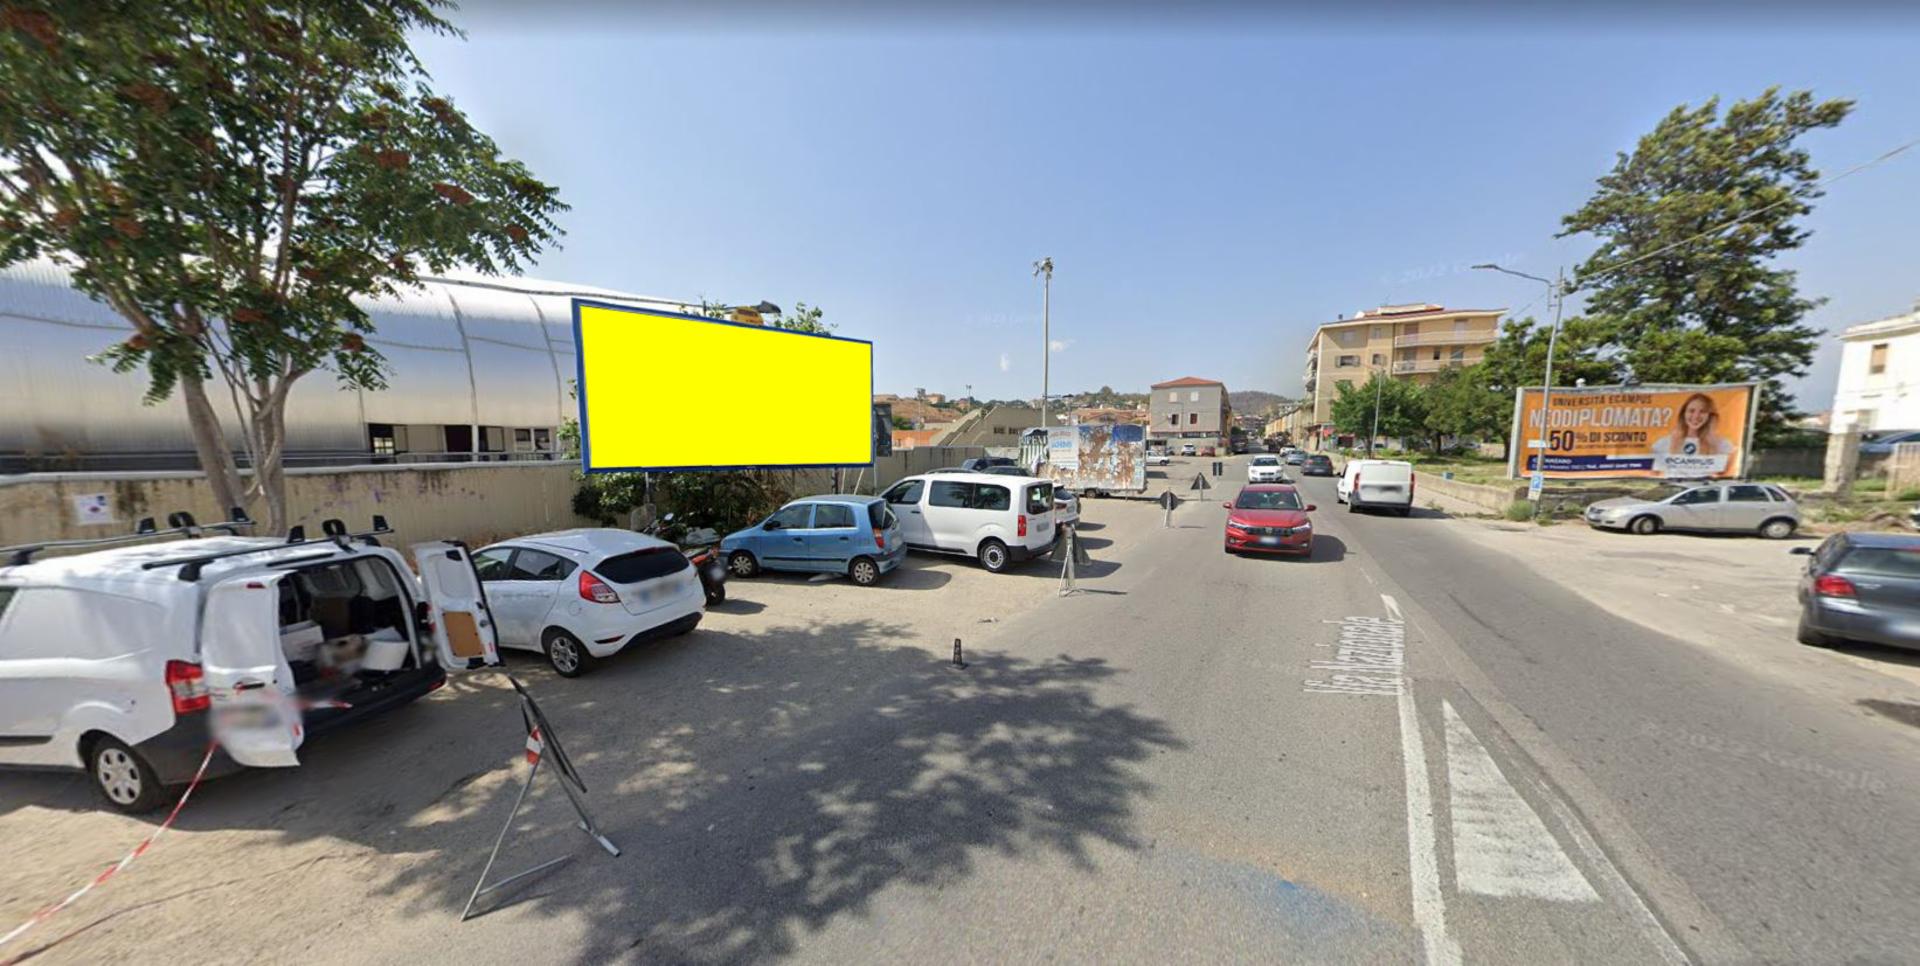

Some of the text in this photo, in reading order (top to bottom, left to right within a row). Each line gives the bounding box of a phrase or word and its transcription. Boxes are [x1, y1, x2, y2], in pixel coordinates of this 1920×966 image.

[1609, 393, 1652, 405] ECAMPUS
[1529, 406, 1673, 428] NEODIPLOMATA?
[1589, 432, 1600, 442] DI
[1603, 431, 1647, 443] SCONTO
